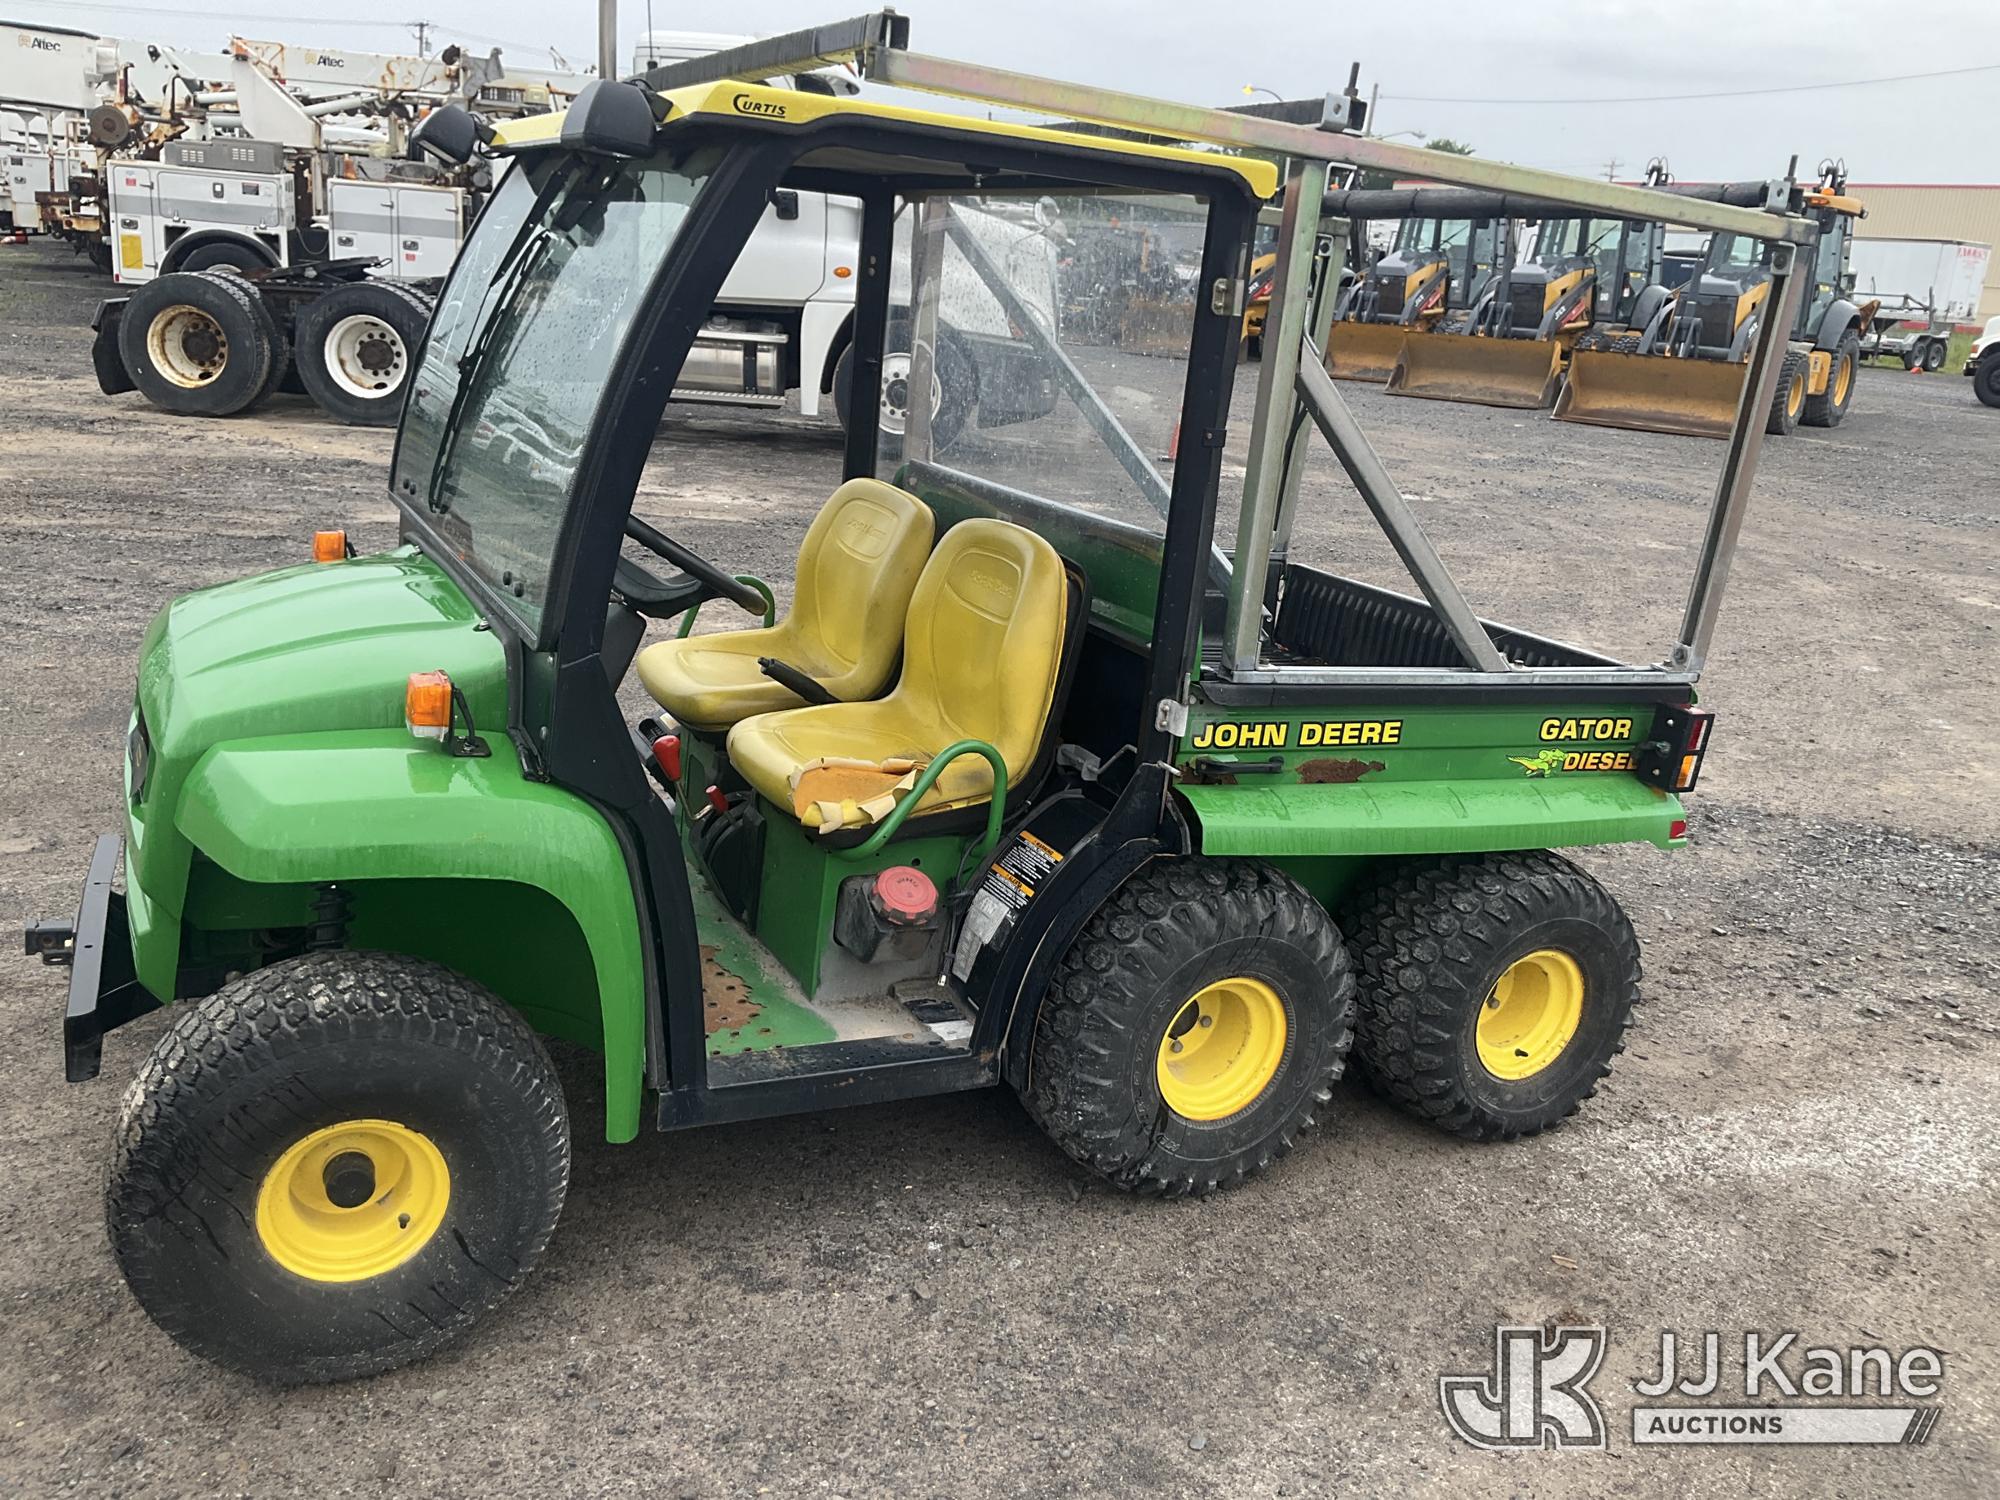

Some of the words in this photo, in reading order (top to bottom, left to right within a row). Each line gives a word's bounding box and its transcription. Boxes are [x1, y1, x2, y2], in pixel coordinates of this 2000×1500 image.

[31, 37, 61, 52] Altec
[316, 54, 345, 68] Altec
[1192, 721, 1289, 749] JOHN
[1297, 719, 1403, 748] DEERE
[1539, 717, 1634, 742] GATOR
